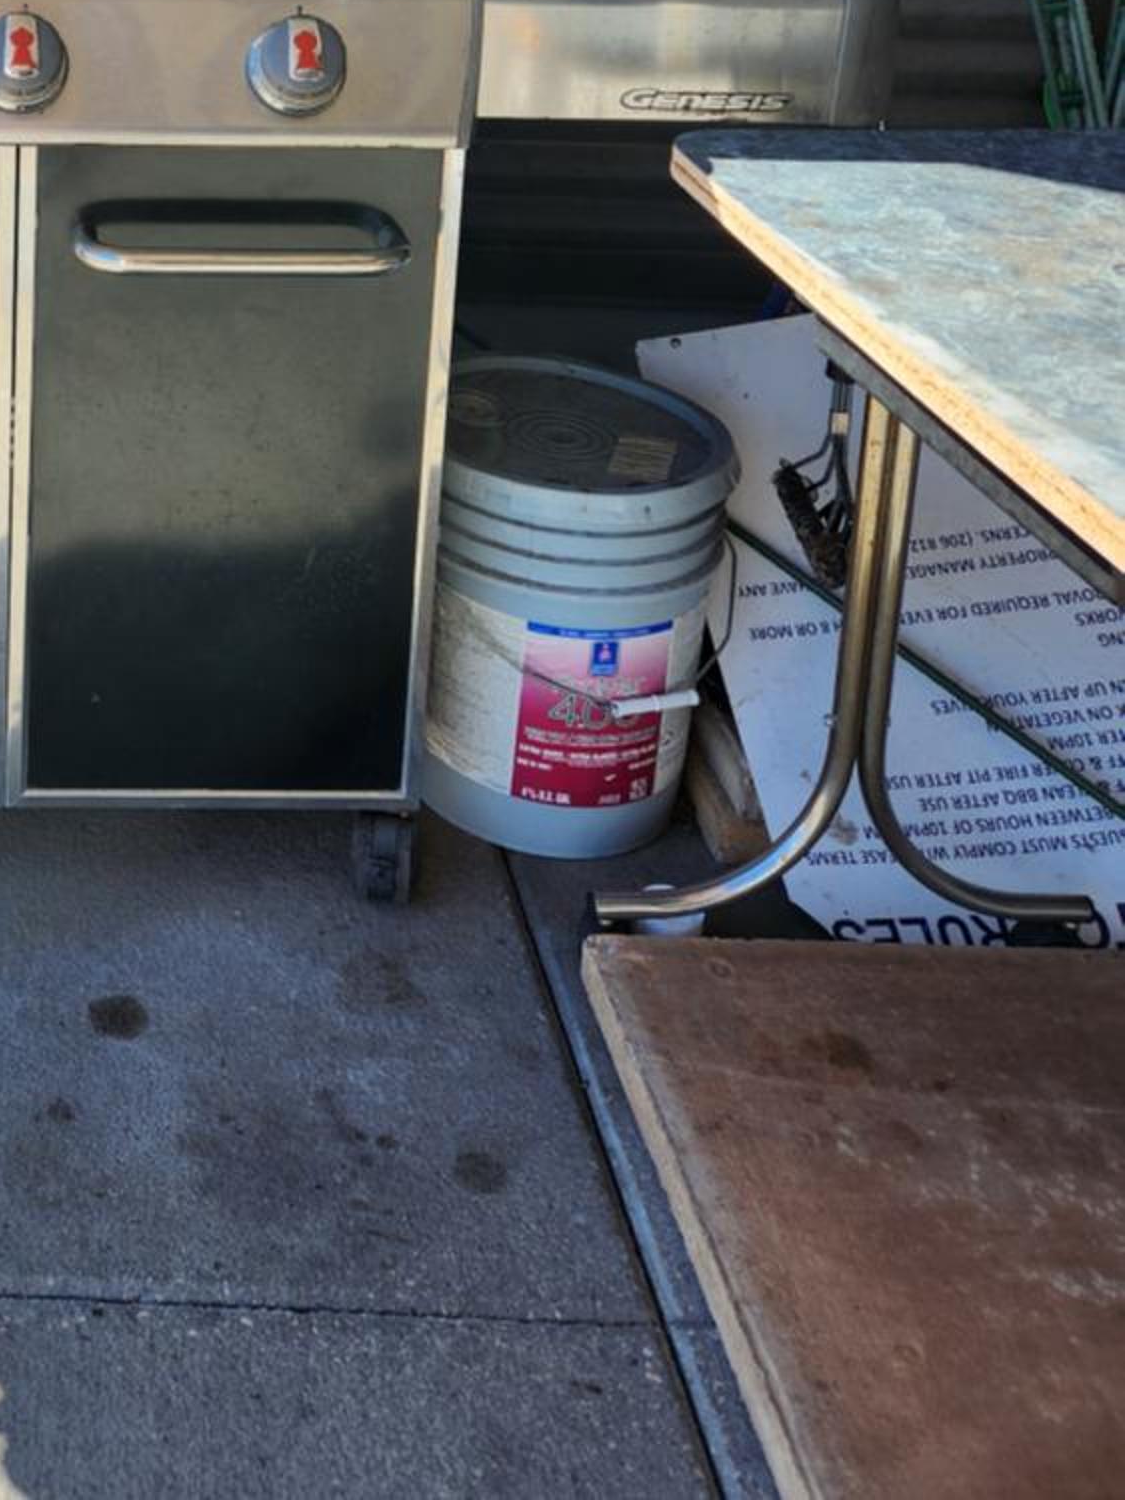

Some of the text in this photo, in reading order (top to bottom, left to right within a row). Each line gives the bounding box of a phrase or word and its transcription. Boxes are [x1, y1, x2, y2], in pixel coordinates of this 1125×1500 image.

[737, 584, 767, 597] ANY
[969, 594, 1049, 615] REQUIRED
[935, 606, 966, 621] FOR
[747, 625, 792, 640] MORE
[794, 622, 815, 636] OR
[1030, 685, 1079, 704] AFTER
[1083, 682, 1106, 696] UP
[1086, 705, 1113, 720] ON
[1046, 732, 1093, 749] 10PM
[914, 771, 961, 786] AFTER
[966, 768, 989, 783] PIT
[995, 765, 1027, 780] FIRE
[952, 793, 999, 809] AFTER
[1000, 788, 1037, 805] BBQ
[918, 799, 948, 812] USE
[1035, 804, 1112, 825] BETWEEN
[952, 820, 972, 835] OF
[976, 814, 1033, 833] HOURS
[952, 841, 1015, 860] COMPLY
[1020, 836, 1068, 855] MUST
